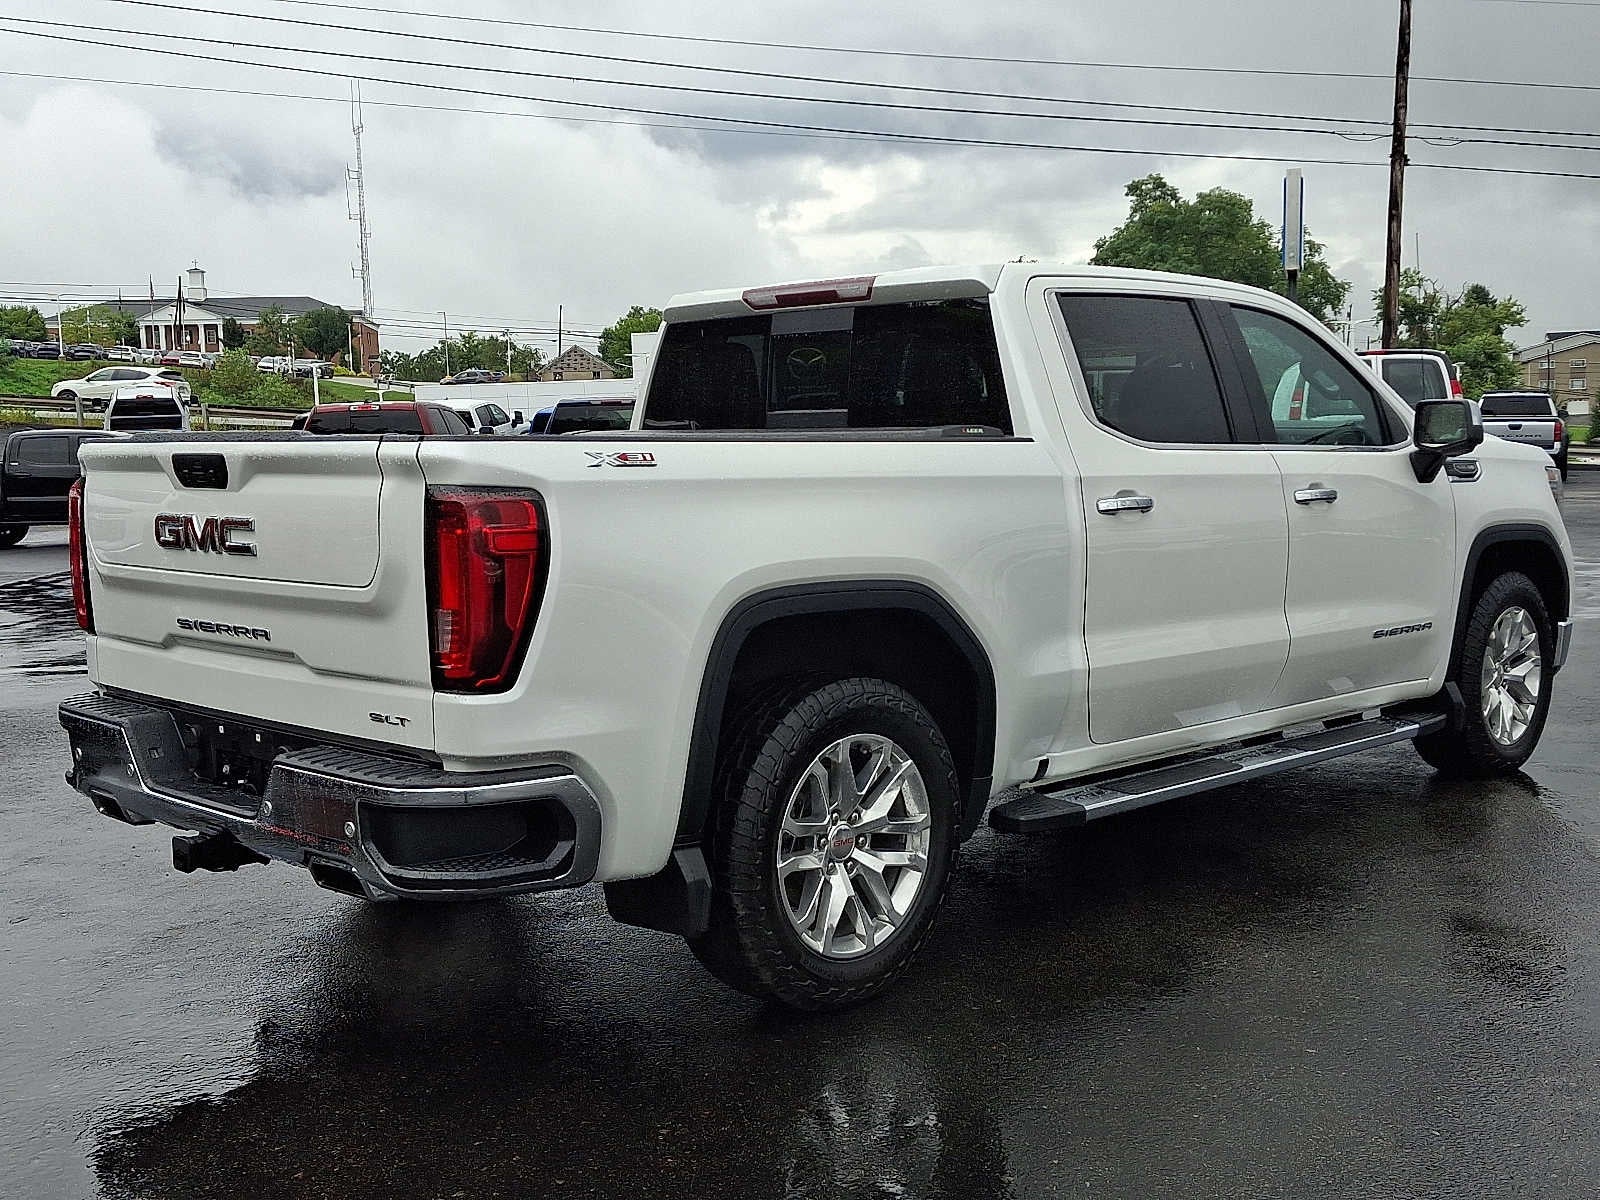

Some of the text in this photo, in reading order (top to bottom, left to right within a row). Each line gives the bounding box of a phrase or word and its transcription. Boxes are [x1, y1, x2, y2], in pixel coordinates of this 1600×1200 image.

[154, 514, 257, 557] GMC
[176, 618, 271, 641] SIERRA
[1372, 621, 1433, 639] SIERRA
[368, 712, 411, 728] SLT
[833, 837, 854, 847] GMC
